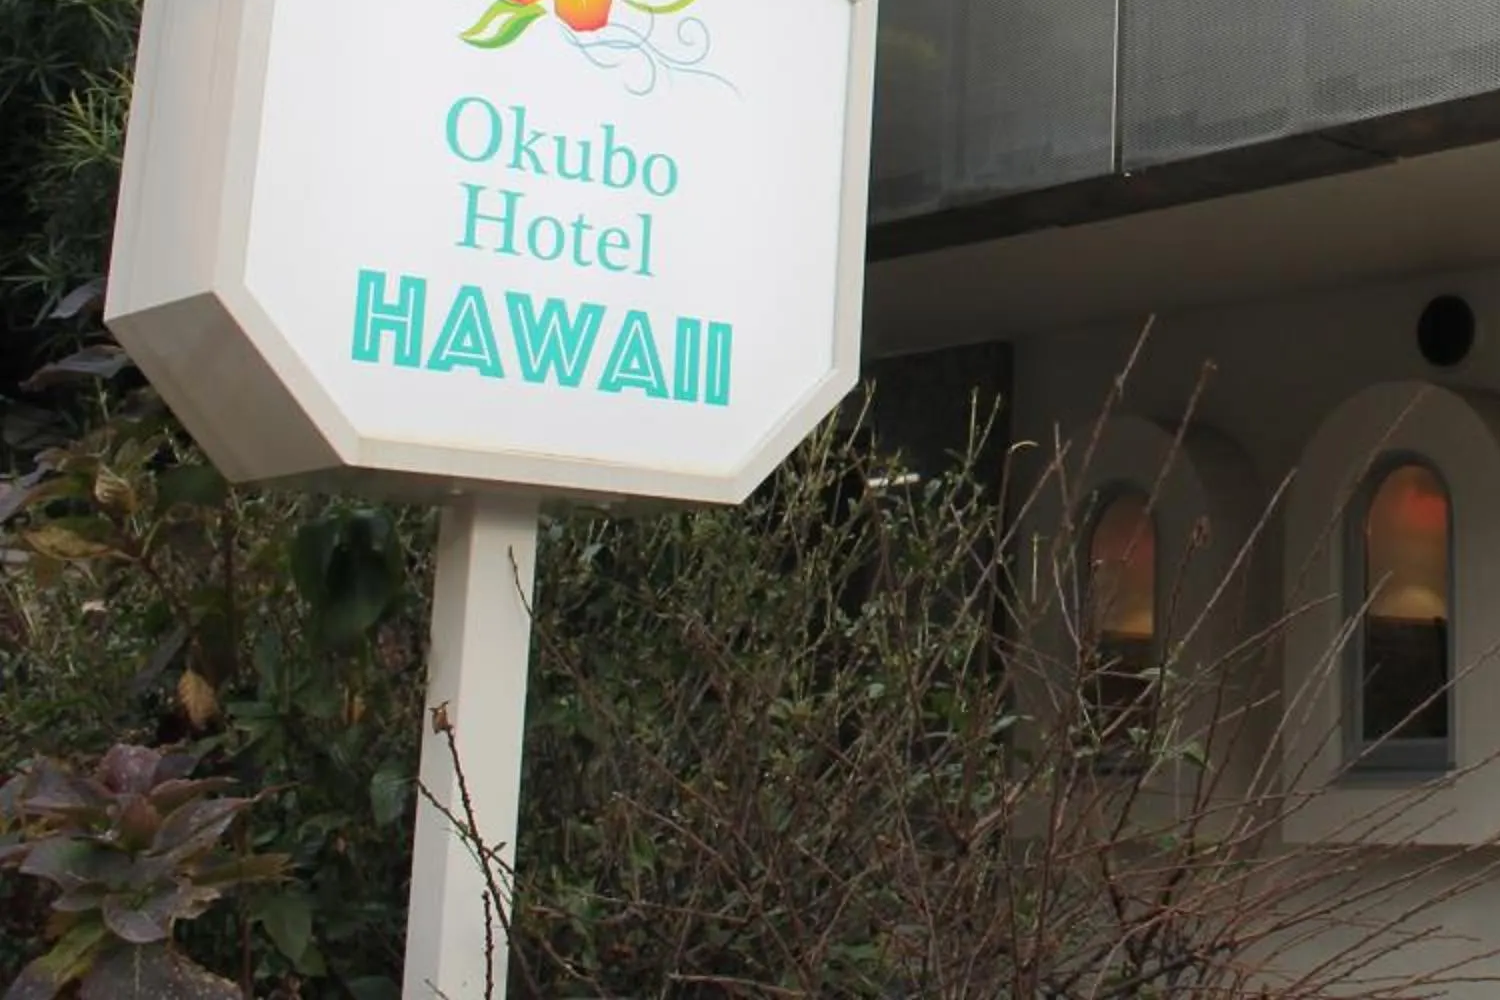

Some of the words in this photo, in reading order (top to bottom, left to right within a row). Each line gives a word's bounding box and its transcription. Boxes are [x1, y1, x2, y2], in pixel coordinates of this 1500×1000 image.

[445, 96, 680, 197] Okubo
[456, 183, 654, 277] Hotel
[350, 268, 734, 407] HAWAII
